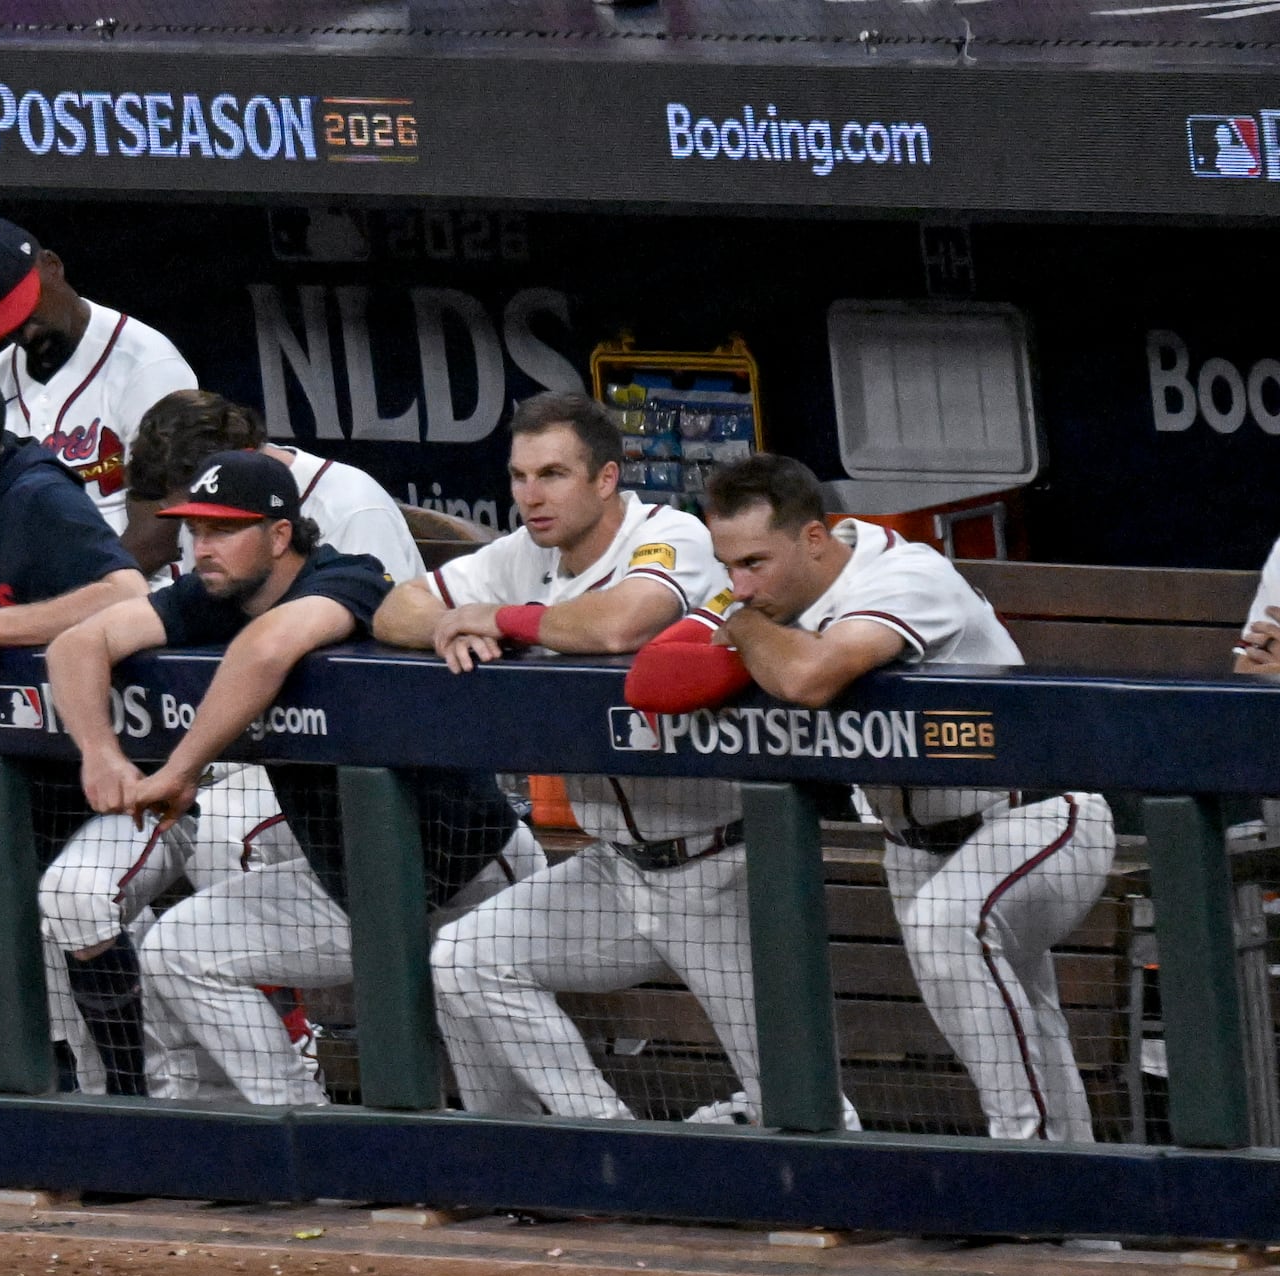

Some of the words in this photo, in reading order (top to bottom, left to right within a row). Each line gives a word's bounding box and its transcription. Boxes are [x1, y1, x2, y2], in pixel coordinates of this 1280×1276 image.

[323, 112, 419, 147] 2026
[667, 103, 931, 176] Booking.com
[249, 283, 588, 443] NLDS
[663, 707, 919, 759] POSTSEASON
[924, 721, 996, 748] 2026
